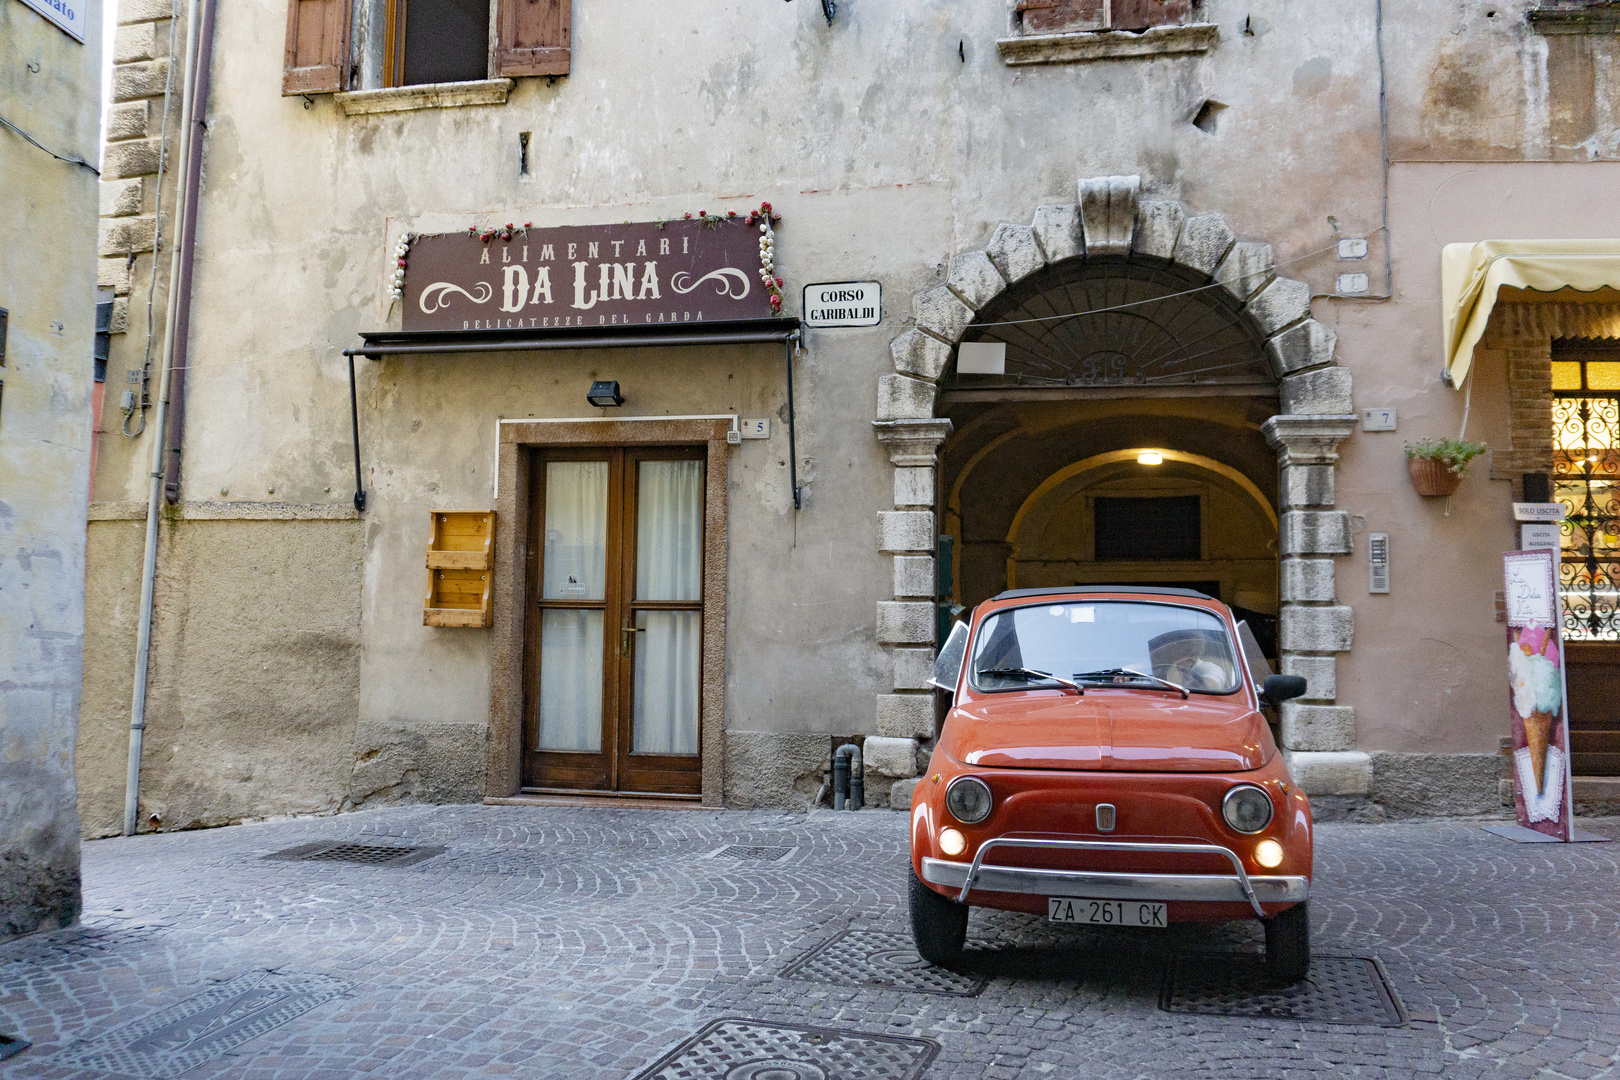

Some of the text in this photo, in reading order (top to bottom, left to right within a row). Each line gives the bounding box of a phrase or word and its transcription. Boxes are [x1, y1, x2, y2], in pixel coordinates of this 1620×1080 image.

[479, 236, 689, 265] ALIMENTARI
[499, 260, 662, 313] DA LINA
[820, 289, 864, 303] CORSO
[463, 310, 703, 330] DELICATEZZE DEL GARDA
[810, 306, 875, 321] GARIBALDI
[1381, 412, 1389, 424] 7
[757, 422, 763, 432] 5
[1051, 899, 1164, 926] ZA 261 CK
